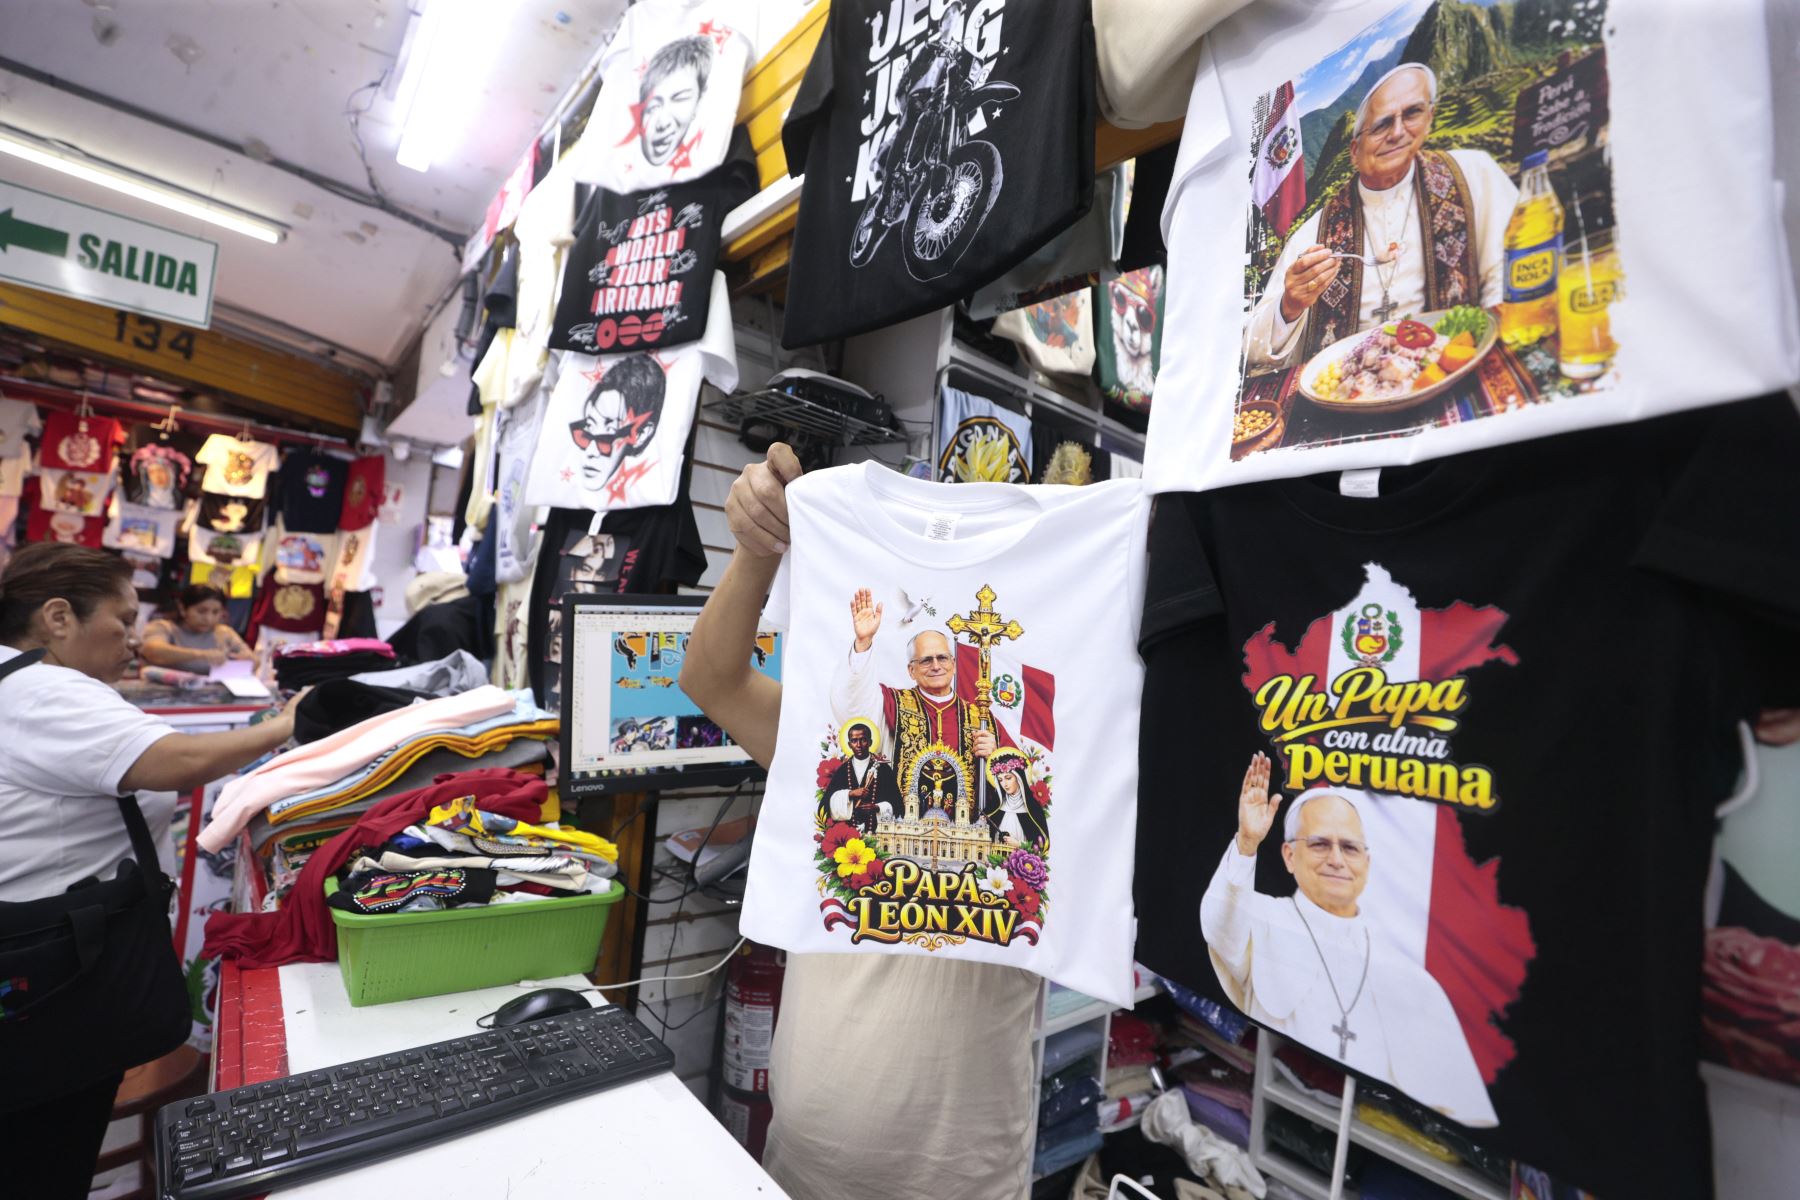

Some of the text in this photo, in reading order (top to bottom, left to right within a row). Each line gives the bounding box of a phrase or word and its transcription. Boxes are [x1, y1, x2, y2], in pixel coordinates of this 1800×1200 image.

[632, 208, 668, 239] BTS
[77, 232, 198, 297] SALIDA
[614, 230, 680, 266] WORLD
[1517, 257, 1549, 272] INCA
[614, 257, 667, 287] TOUR
[1516, 268, 1549, 282] KOLA
[595, 279, 680, 316] ARIRANG
[113, 309, 197, 362] 134
[1254, 667, 1467, 731] Un Papa
[1323, 726, 1450, 759] con alma
[570, 783, 605, 793] Lenovo
[1284, 742, 1496, 810] peruana
[882, 858, 982, 905] PAPÁ
[848, 895, 1020, 945] LEÓN XIV
